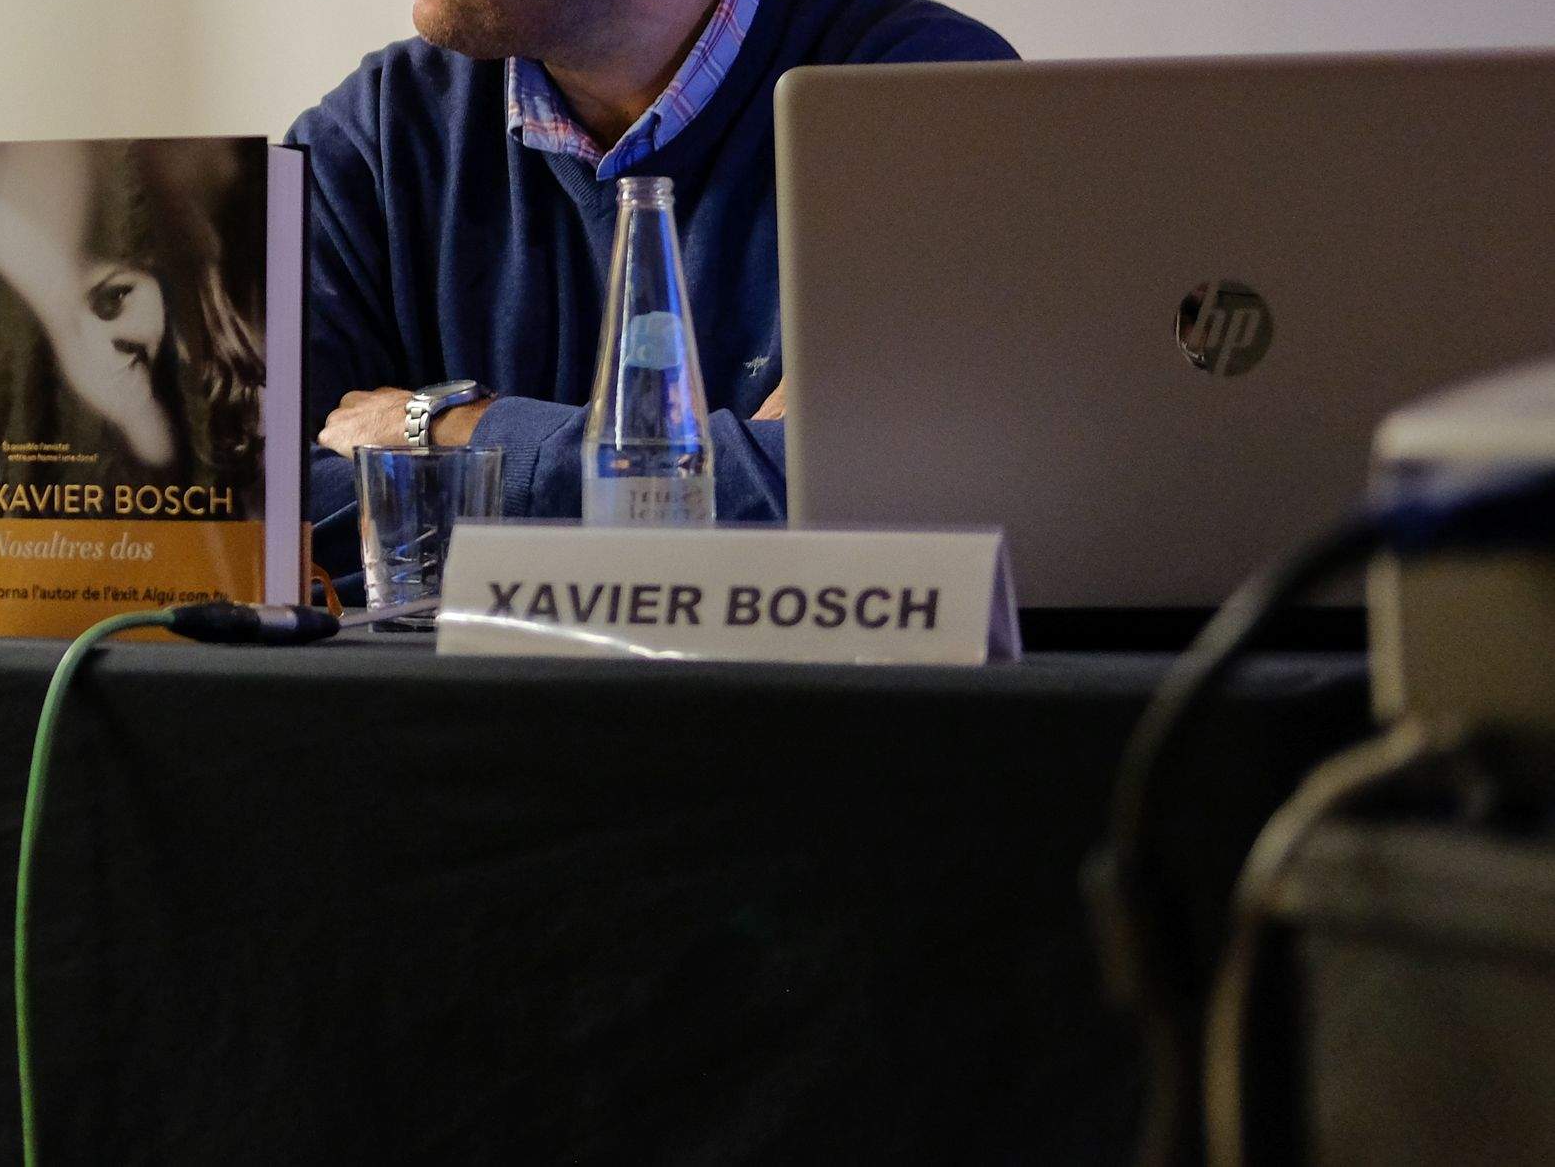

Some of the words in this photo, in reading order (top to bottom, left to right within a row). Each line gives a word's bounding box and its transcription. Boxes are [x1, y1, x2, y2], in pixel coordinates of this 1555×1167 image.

[1192, 282, 1261, 376] hp
[115, 485, 233, 515] BOSCH
[110, 532, 155, 561] dos
[82, 586, 100, 601] de
[487, 581, 701, 627] XAVIER
[725, 586, 941, 630] BOSCH
